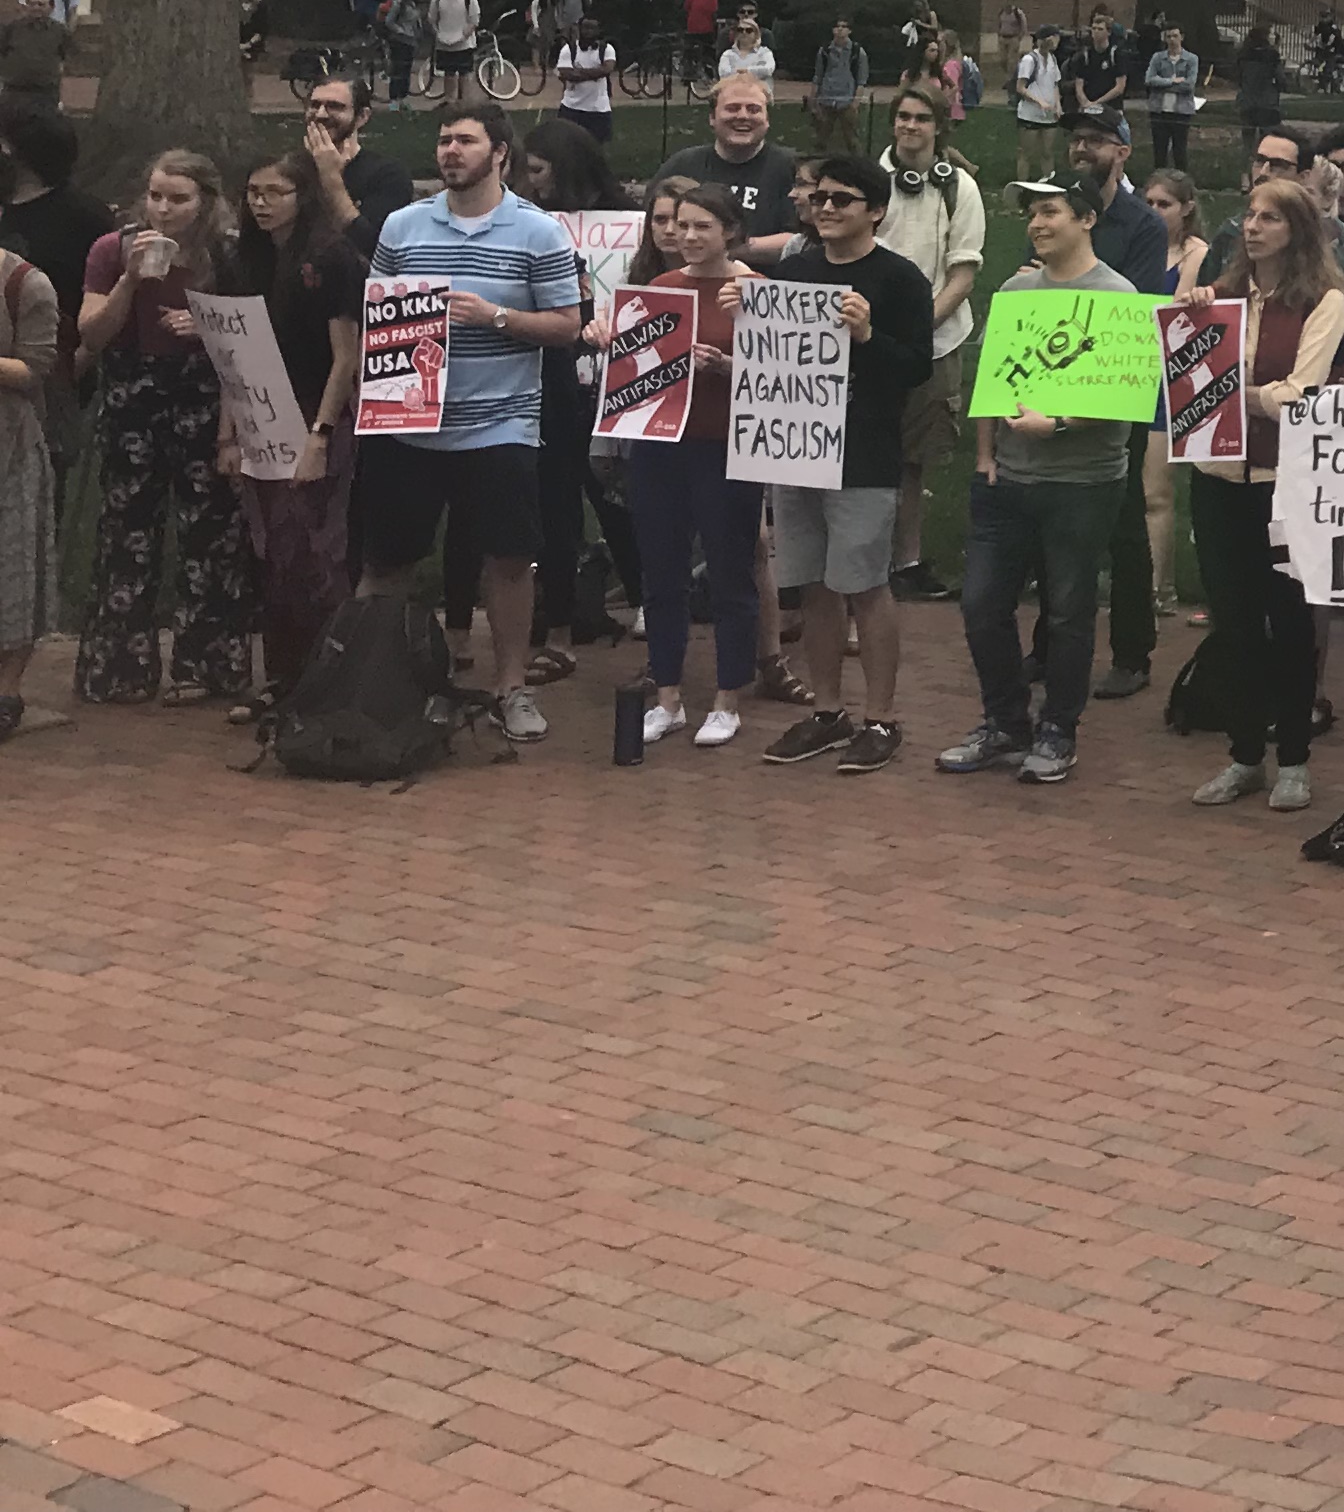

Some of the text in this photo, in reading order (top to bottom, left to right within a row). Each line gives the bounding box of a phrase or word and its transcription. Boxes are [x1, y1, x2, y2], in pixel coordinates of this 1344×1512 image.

[368, 294, 446, 324] NO KKK
[740, 281, 847, 329] WORKERS
[369, 321, 444, 346] NO FASCIST
[610, 313, 676, 359] ALWAYS
[738, 325, 841, 366] UNITED
[1167, 329, 1222, 380] ALWAYS
[368, 351, 411, 375] USA
[1094, 354, 1160, 368] WHITE
[603, 356, 690, 415] ANTIFASCIST
[735, 368, 845, 407] AGAINST
[1171, 368, 1241, 438] ANTIFASCIST
[734, 413, 843, 463] FASCISM
